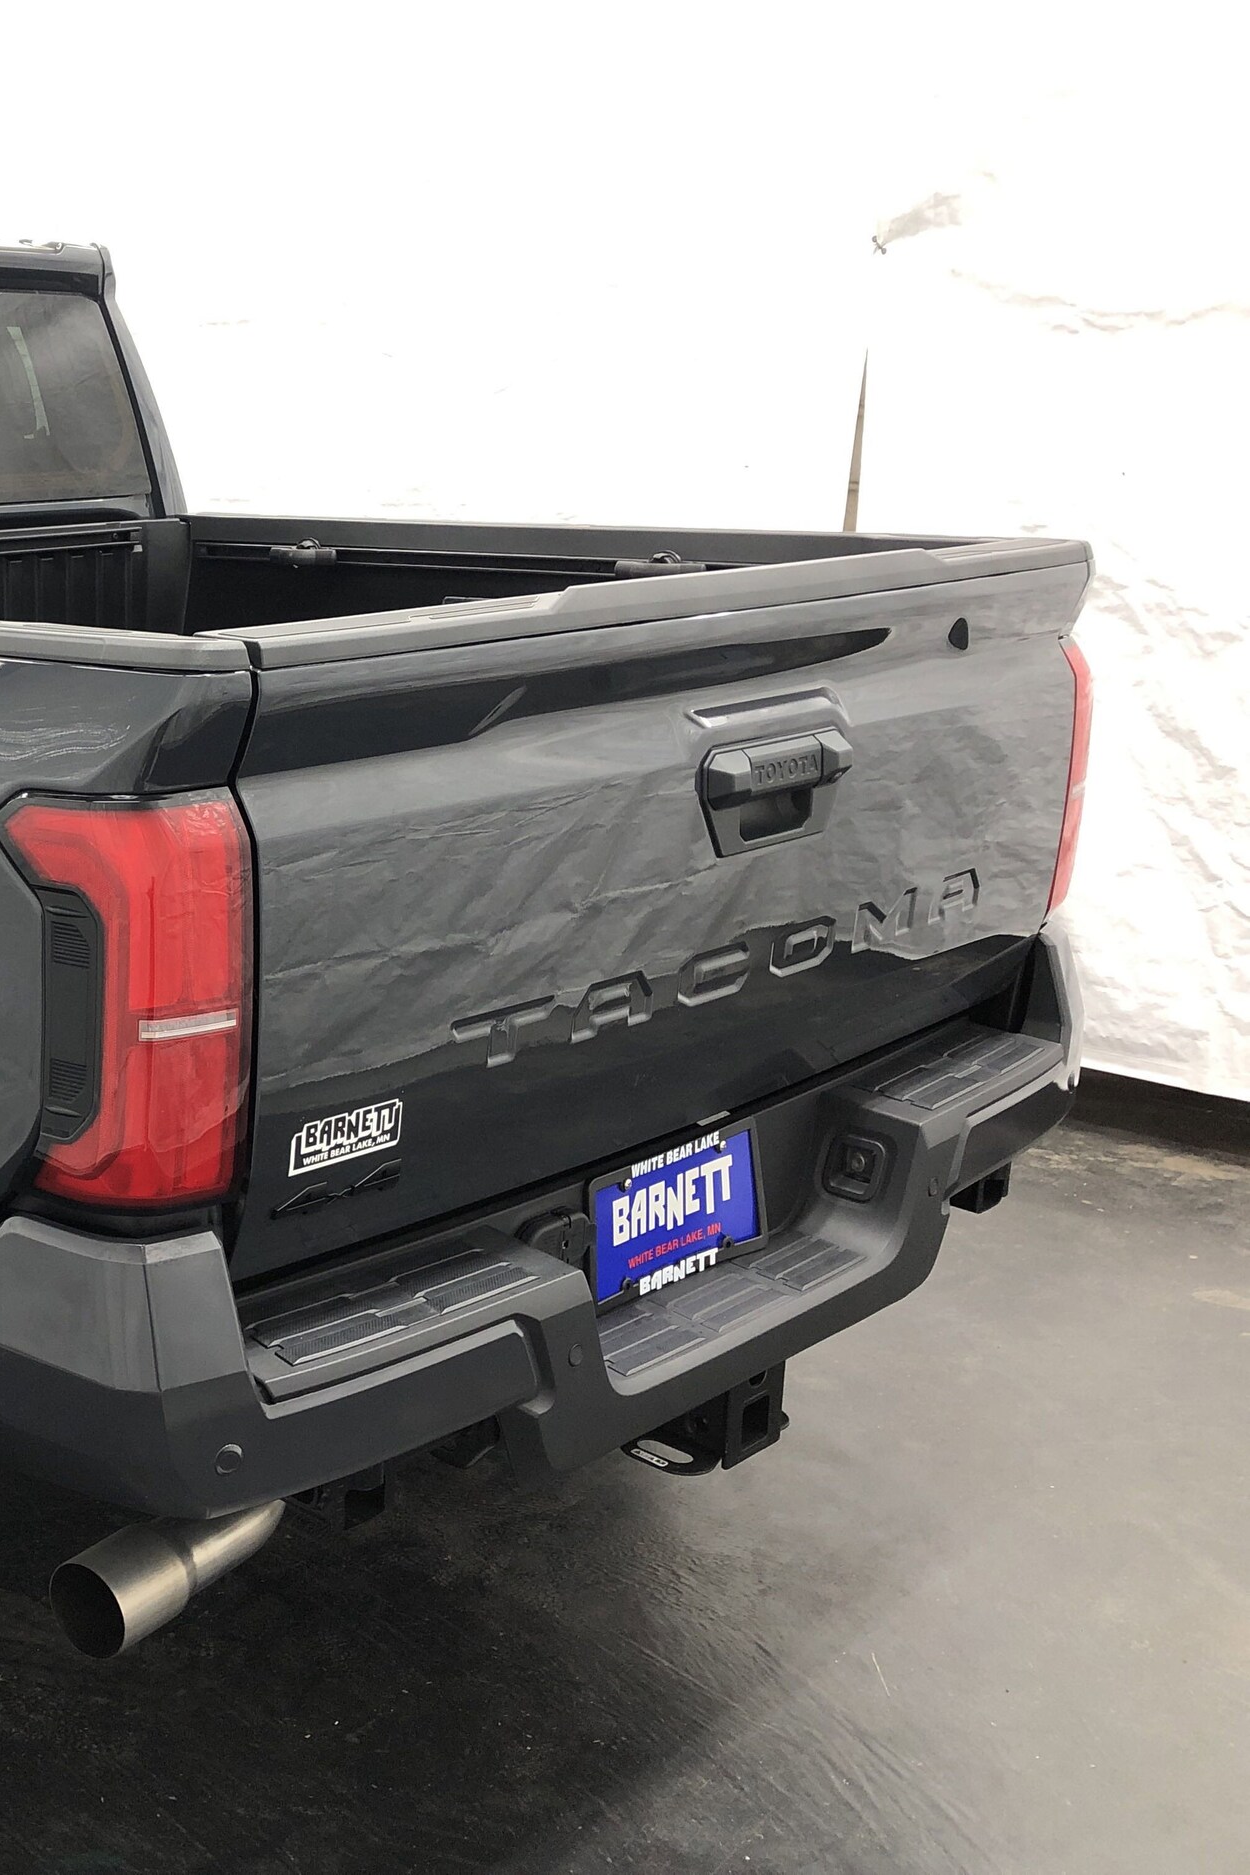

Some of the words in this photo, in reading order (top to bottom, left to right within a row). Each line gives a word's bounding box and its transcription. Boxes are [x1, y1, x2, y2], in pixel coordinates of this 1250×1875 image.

[754, 753, 819, 786] TOYOTA
[450, 867, 981, 1068] TACOMA
[302, 1100, 399, 1152] BARNETT
[302, 1151, 329, 1166] WHITE
[329, 1145, 351, 1158] BEAR
[352, 1138, 377, 1153] LAKE,
[376, 1132, 391, 1145] MN
[631, 1152, 664, 1179] WHITE
[666, 1143, 693, 1166] BEAR
[694, 1131, 720, 1154] LAKE
[612, 1154, 733, 1247] BARNETT
[628, 1248, 654, 1269] WHITE
[655, 1240, 679, 1258] BEAR
[680, 1229, 706, 1246] LAKE,
[707, 1222, 722, 1236] MN
[639, 1247, 719, 1296] BARNETT
